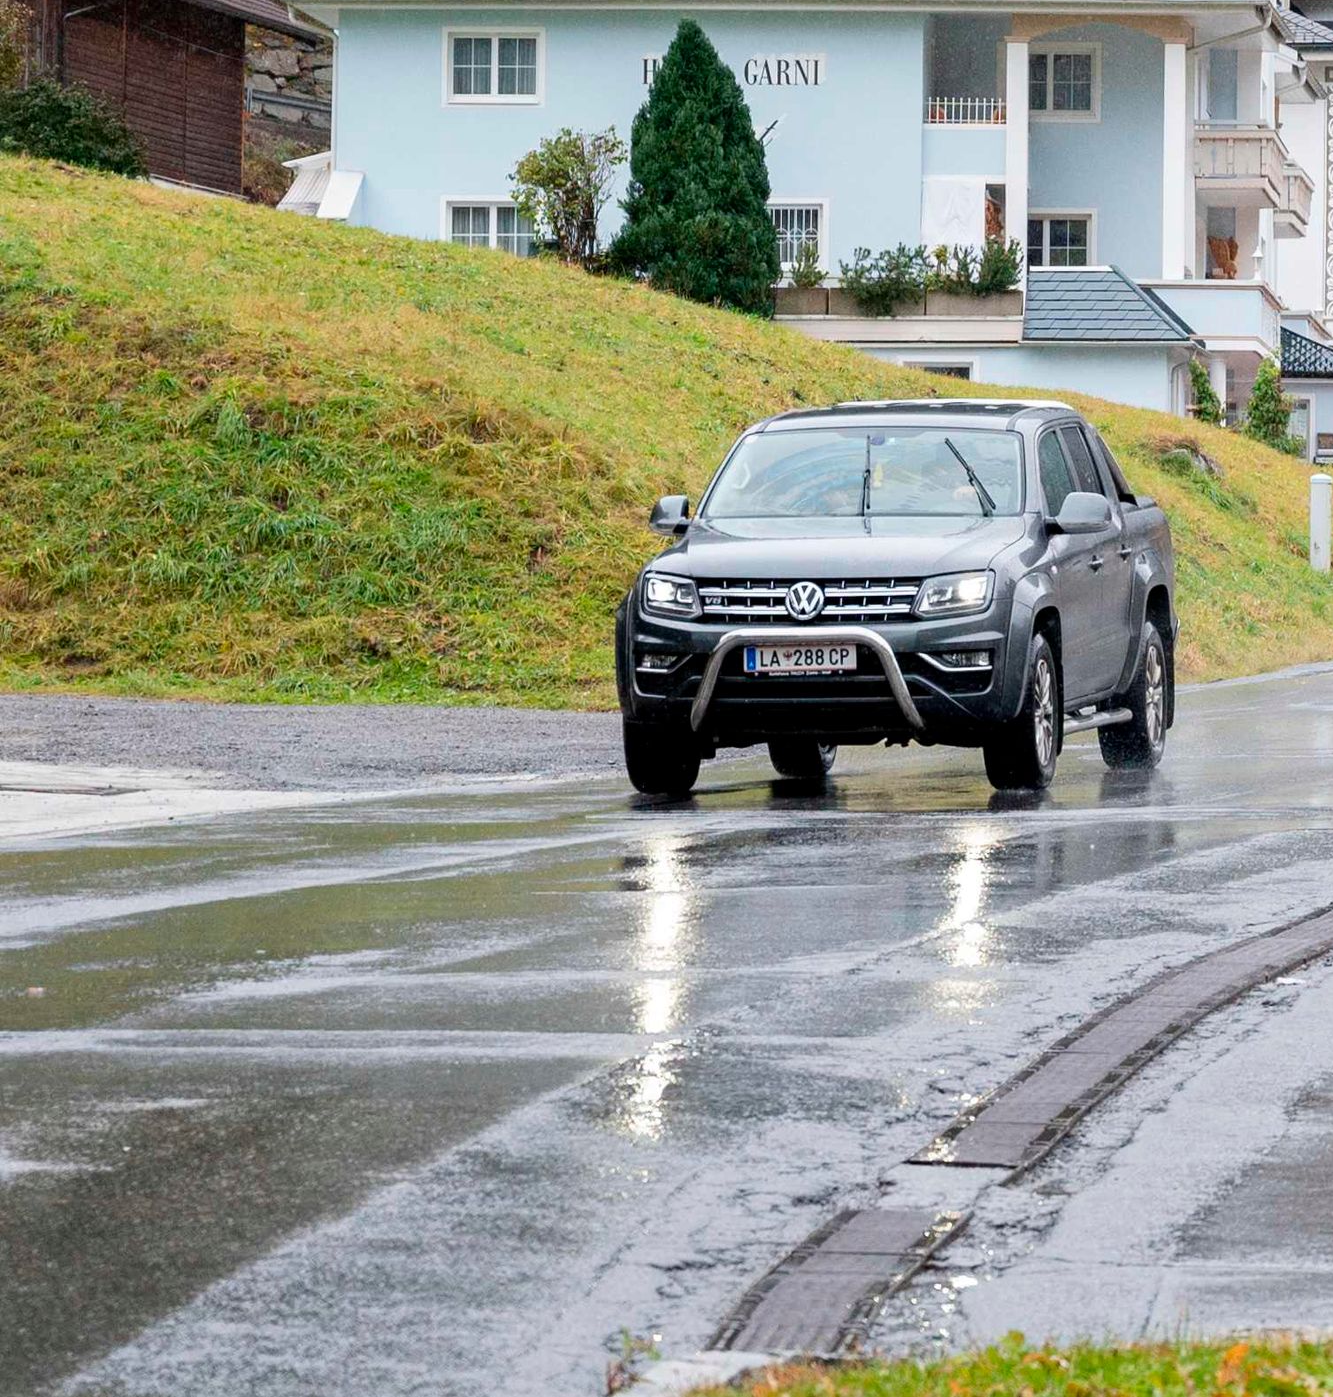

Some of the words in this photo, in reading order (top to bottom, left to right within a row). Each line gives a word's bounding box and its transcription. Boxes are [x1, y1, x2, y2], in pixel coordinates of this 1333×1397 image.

[743, 58, 820, 86] GARNI
[760, 650, 781, 667] LA
[793, 649, 825, 666] 288
[828, 648, 850, 666] CP
